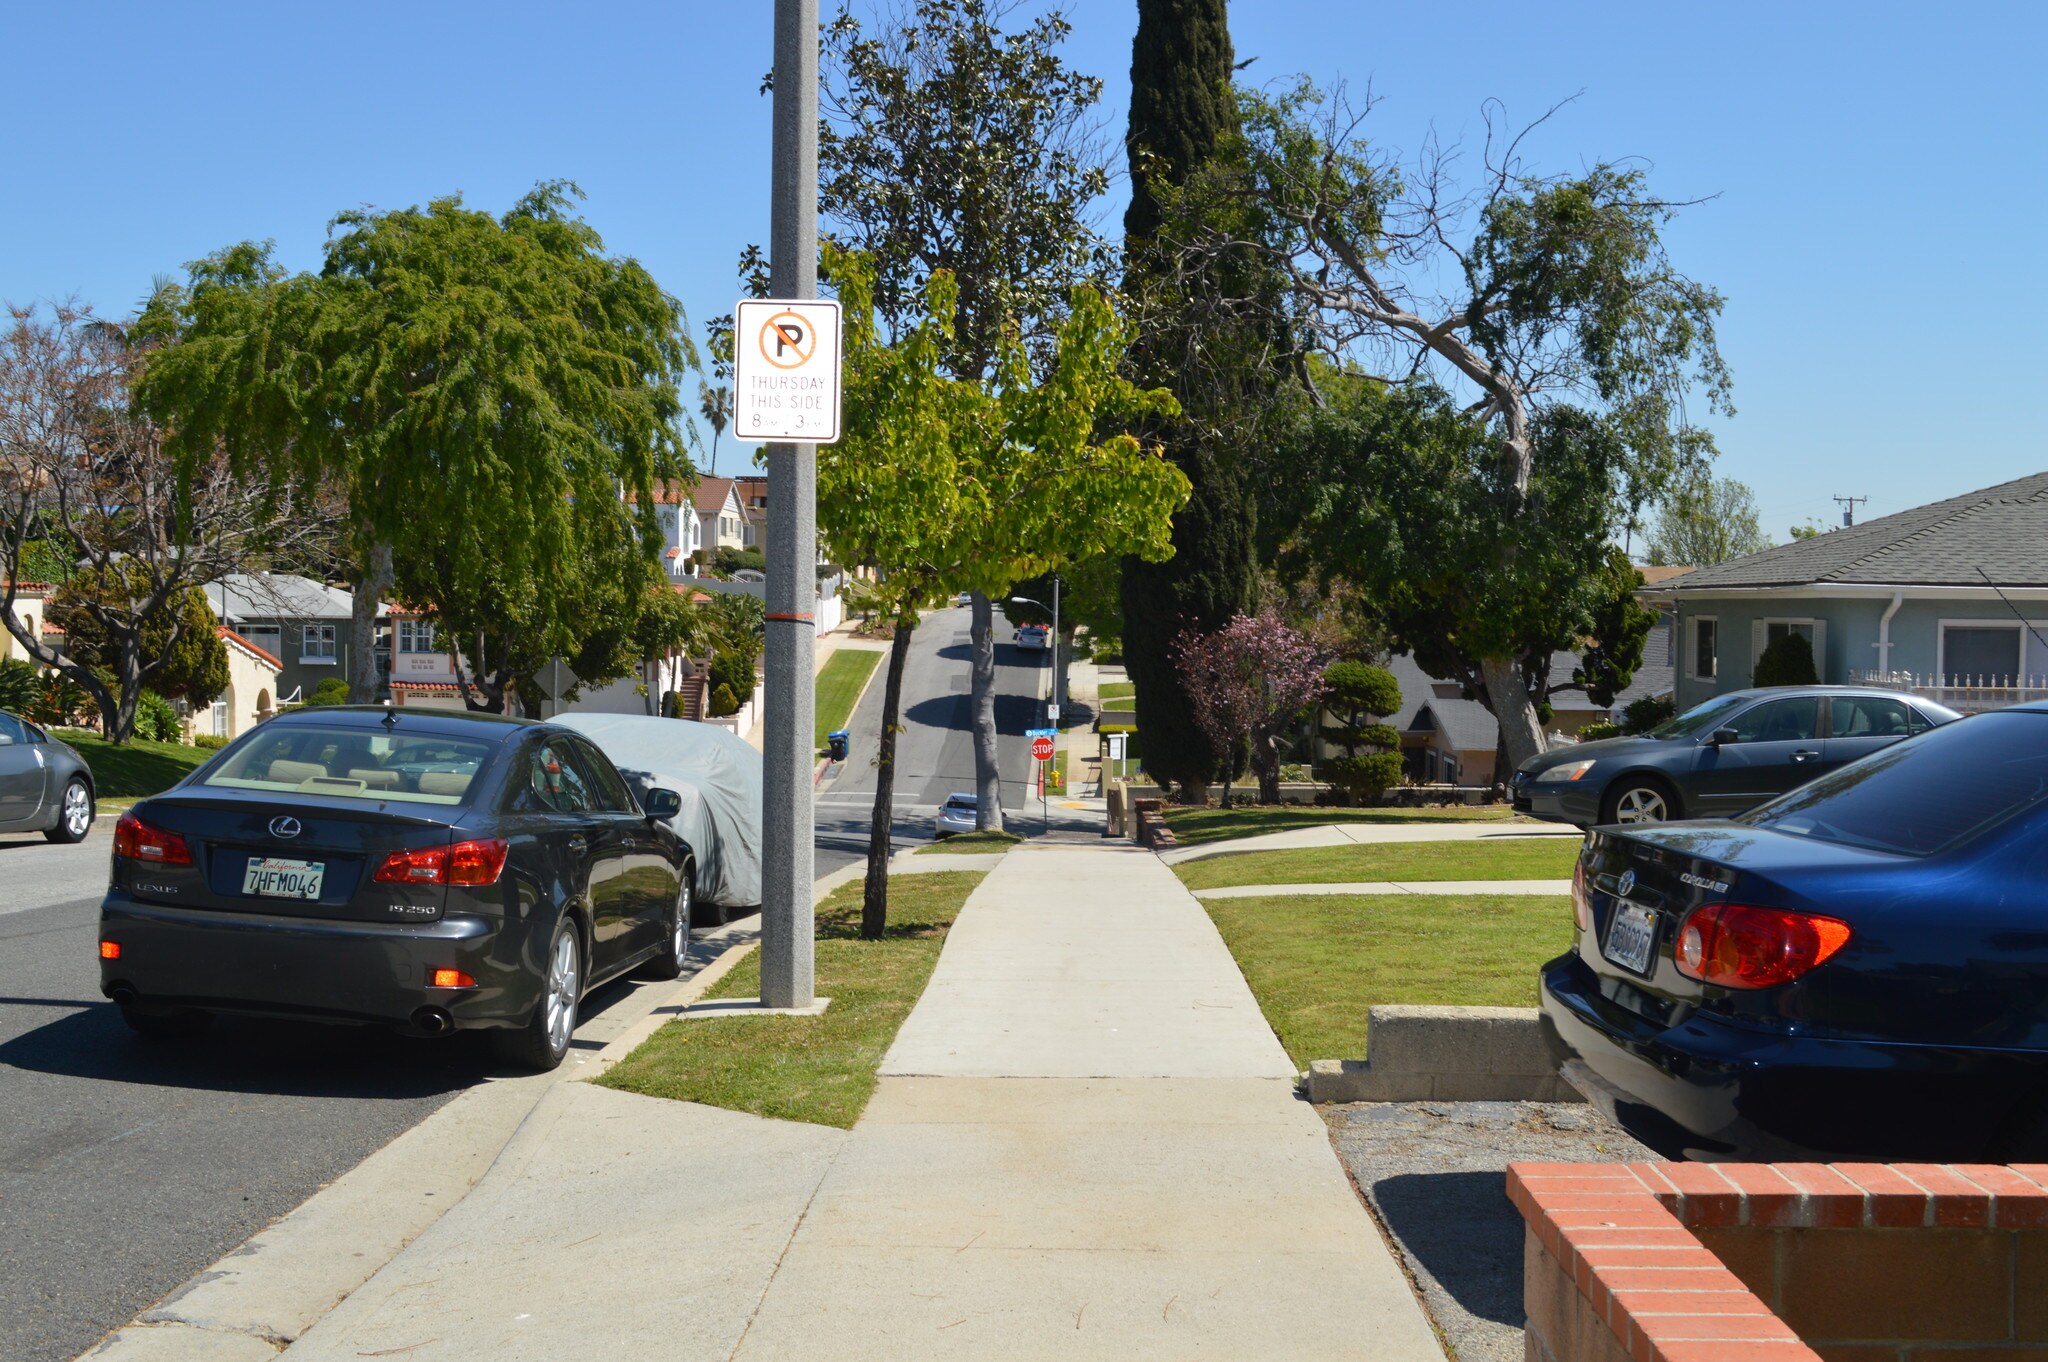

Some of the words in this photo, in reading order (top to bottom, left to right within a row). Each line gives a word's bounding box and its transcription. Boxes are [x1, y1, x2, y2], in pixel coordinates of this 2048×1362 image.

[752, 375, 826, 390] THURSDAY
[751, 394, 782, 409] THIS
[790, 395, 823, 410] SIDE
[1032, 744, 1053, 755] STOP
[262, 858, 307, 872] California
[249, 870, 319, 894] 7HFM046
[1680, 872, 1716, 890] COROLLA
[137, 883, 178, 894] LEXUS
[389, 904, 404, 913] IS
[406, 905, 436, 915] 250
